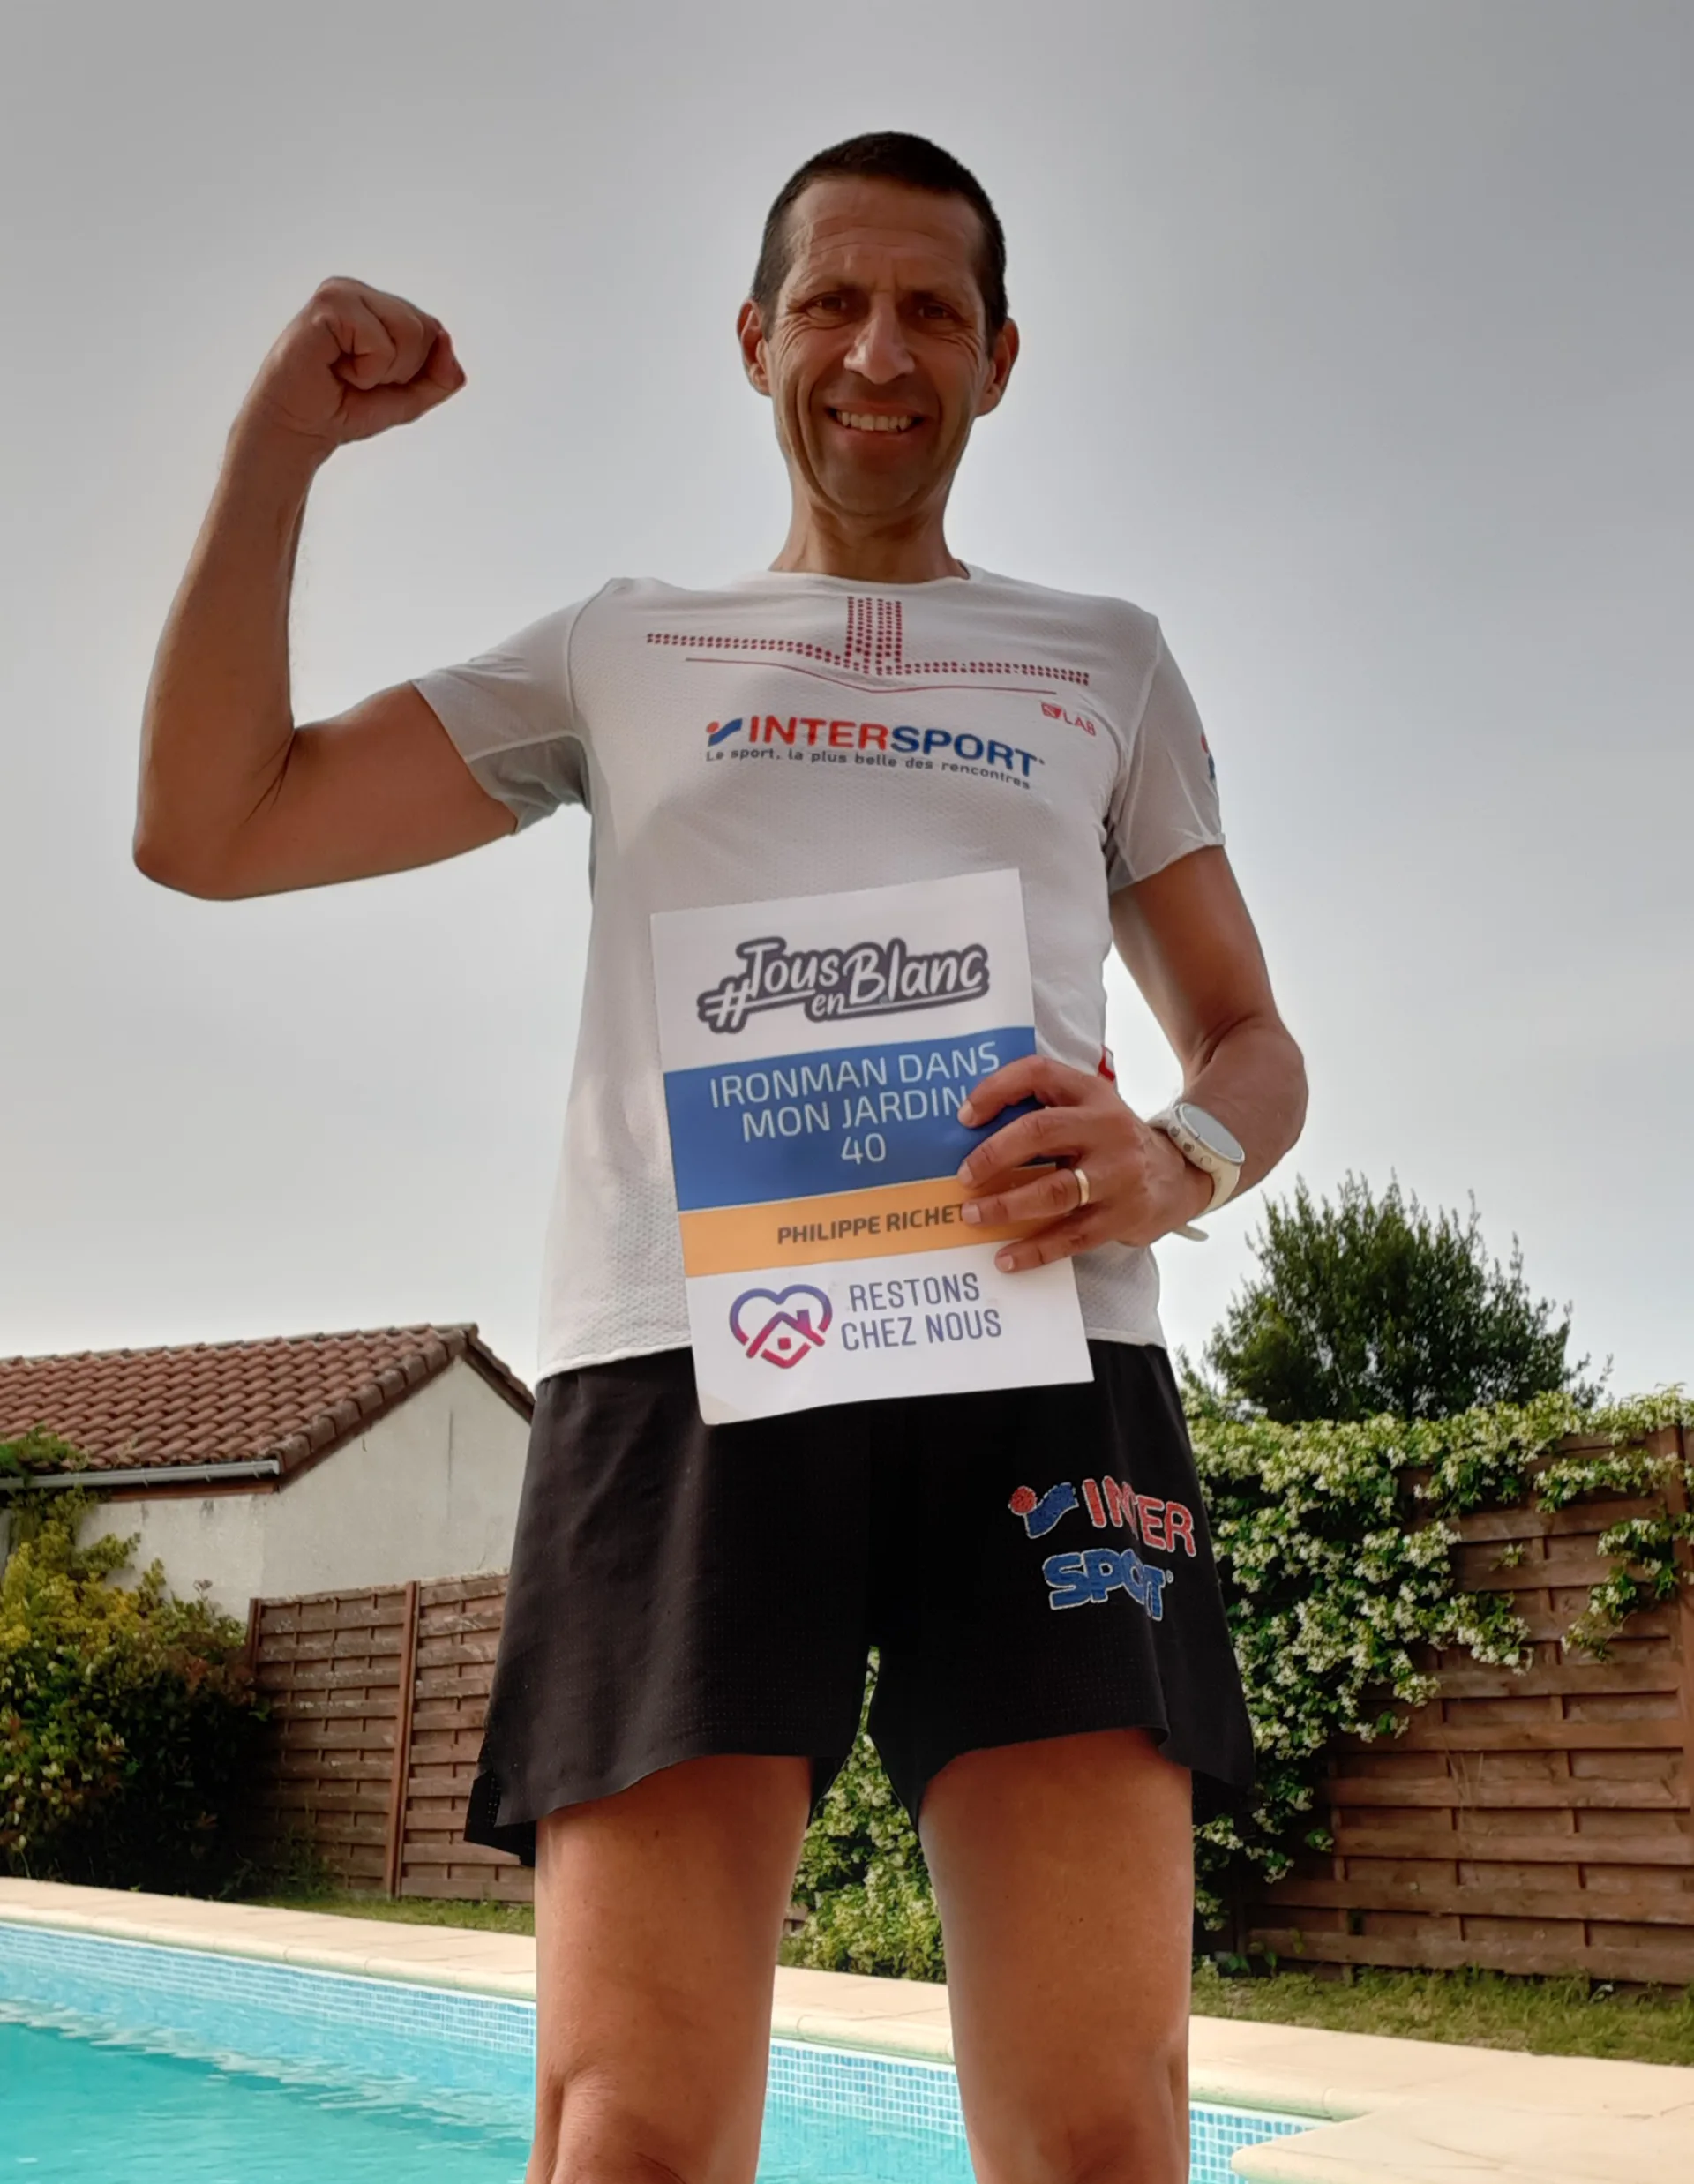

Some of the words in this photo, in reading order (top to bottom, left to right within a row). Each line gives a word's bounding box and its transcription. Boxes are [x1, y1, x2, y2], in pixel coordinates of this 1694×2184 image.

[1063, 710, 1097, 737] LAB
[748, 715, 1038, 777] INTERSPORT
[706, 751, 723, 762] Le
[788, 748, 804, 760] la
[811, 751, 847, 764] plus
[854, 752, 897, 768] belle
[905, 757, 933, 770] des
[941, 761, 1031, 790] rencontres
[841, 940, 987, 1006] Blanc
[710, 1057, 888, 1108] IRONMAN
[898, 1041, 1000, 1084] DANS
[742, 1101, 830, 1142] MON
[842, 1086, 968, 1129] JARDIN
[841, 1133, 887, 1165] 40
[777, 1215, 881, 1245] PHILIPPE
[849, 1272, 980, 1313] RESTONS
[841, 1316, 917, 1351] CHEZ
[926, 1309, 1001, 1344] NOUS
